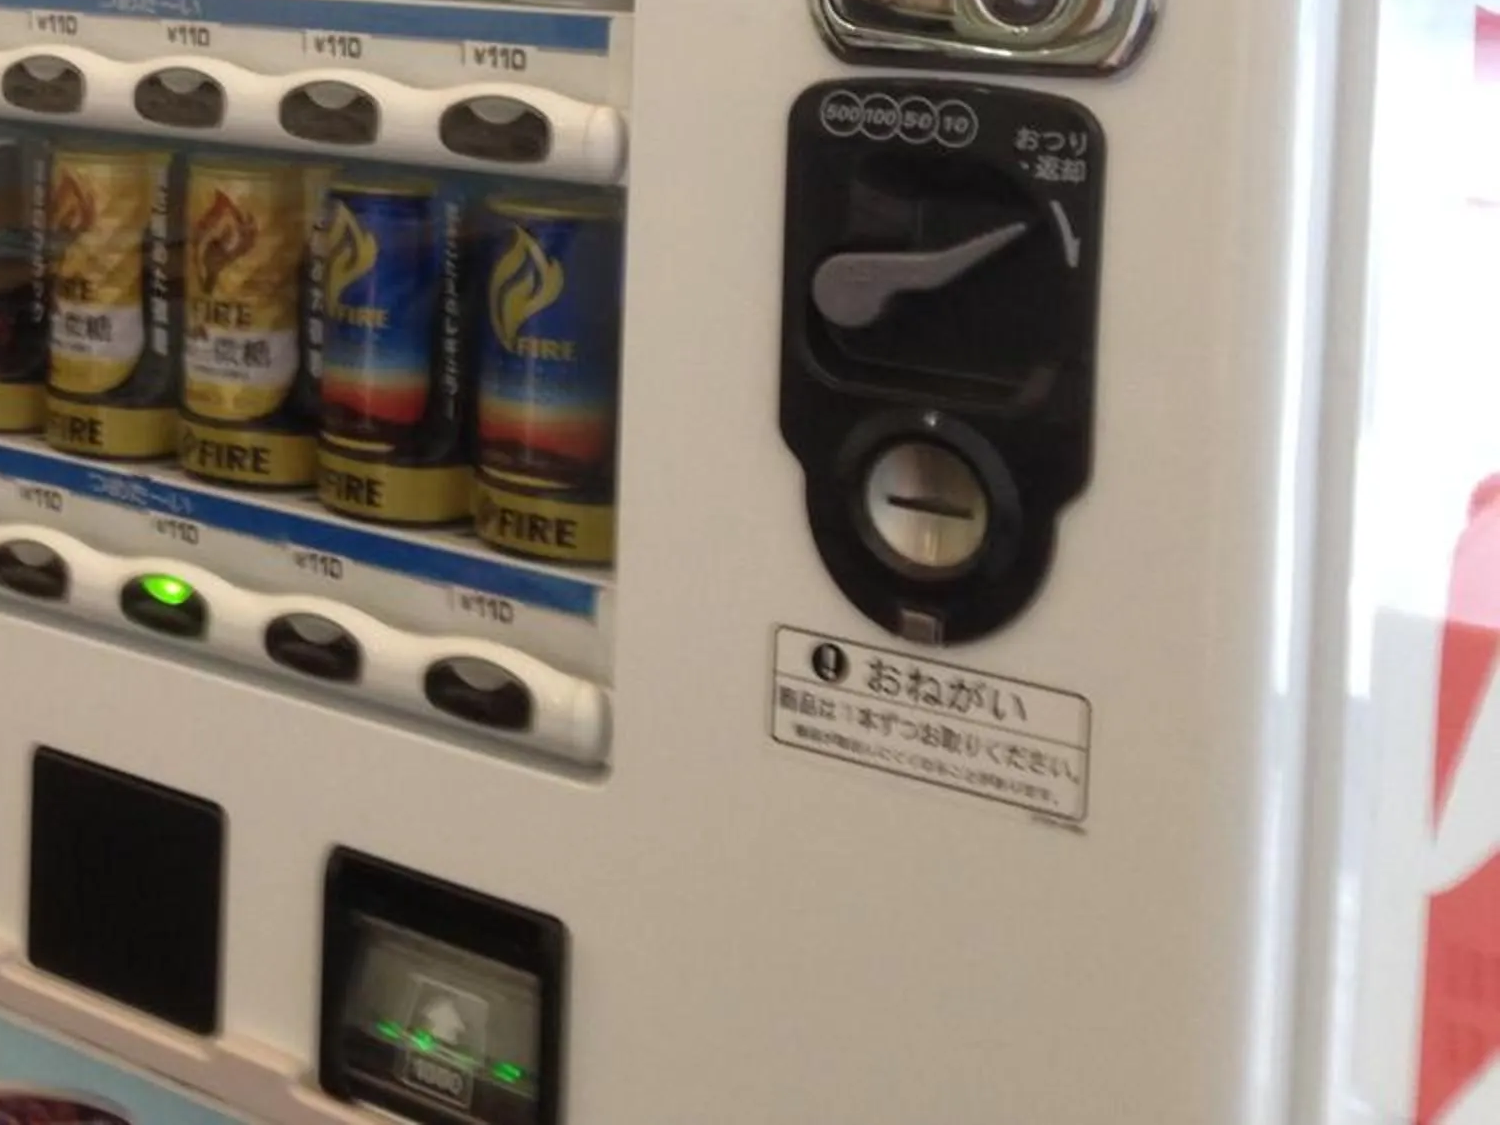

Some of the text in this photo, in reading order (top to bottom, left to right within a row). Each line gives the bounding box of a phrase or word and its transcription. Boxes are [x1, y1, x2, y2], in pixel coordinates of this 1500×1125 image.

[37, 13, 77, 36] ¥110
[167, 25, 211, 49] ¥110
[313, 35, 363, 59] ¥110
[473, 46, 527, 71] ¥110
[825, 104, 970, 134] 500 100 50 10
[1015, 127, 1088, 156] おつり
[198, 438, 272, 475] FIRE
[498, 508, 578, 550] FIRE
[295, 550, 344, 580] ¥110
[460, 594, 515, 625] ¥110
[865, 657, 1029, 723] おねがい
